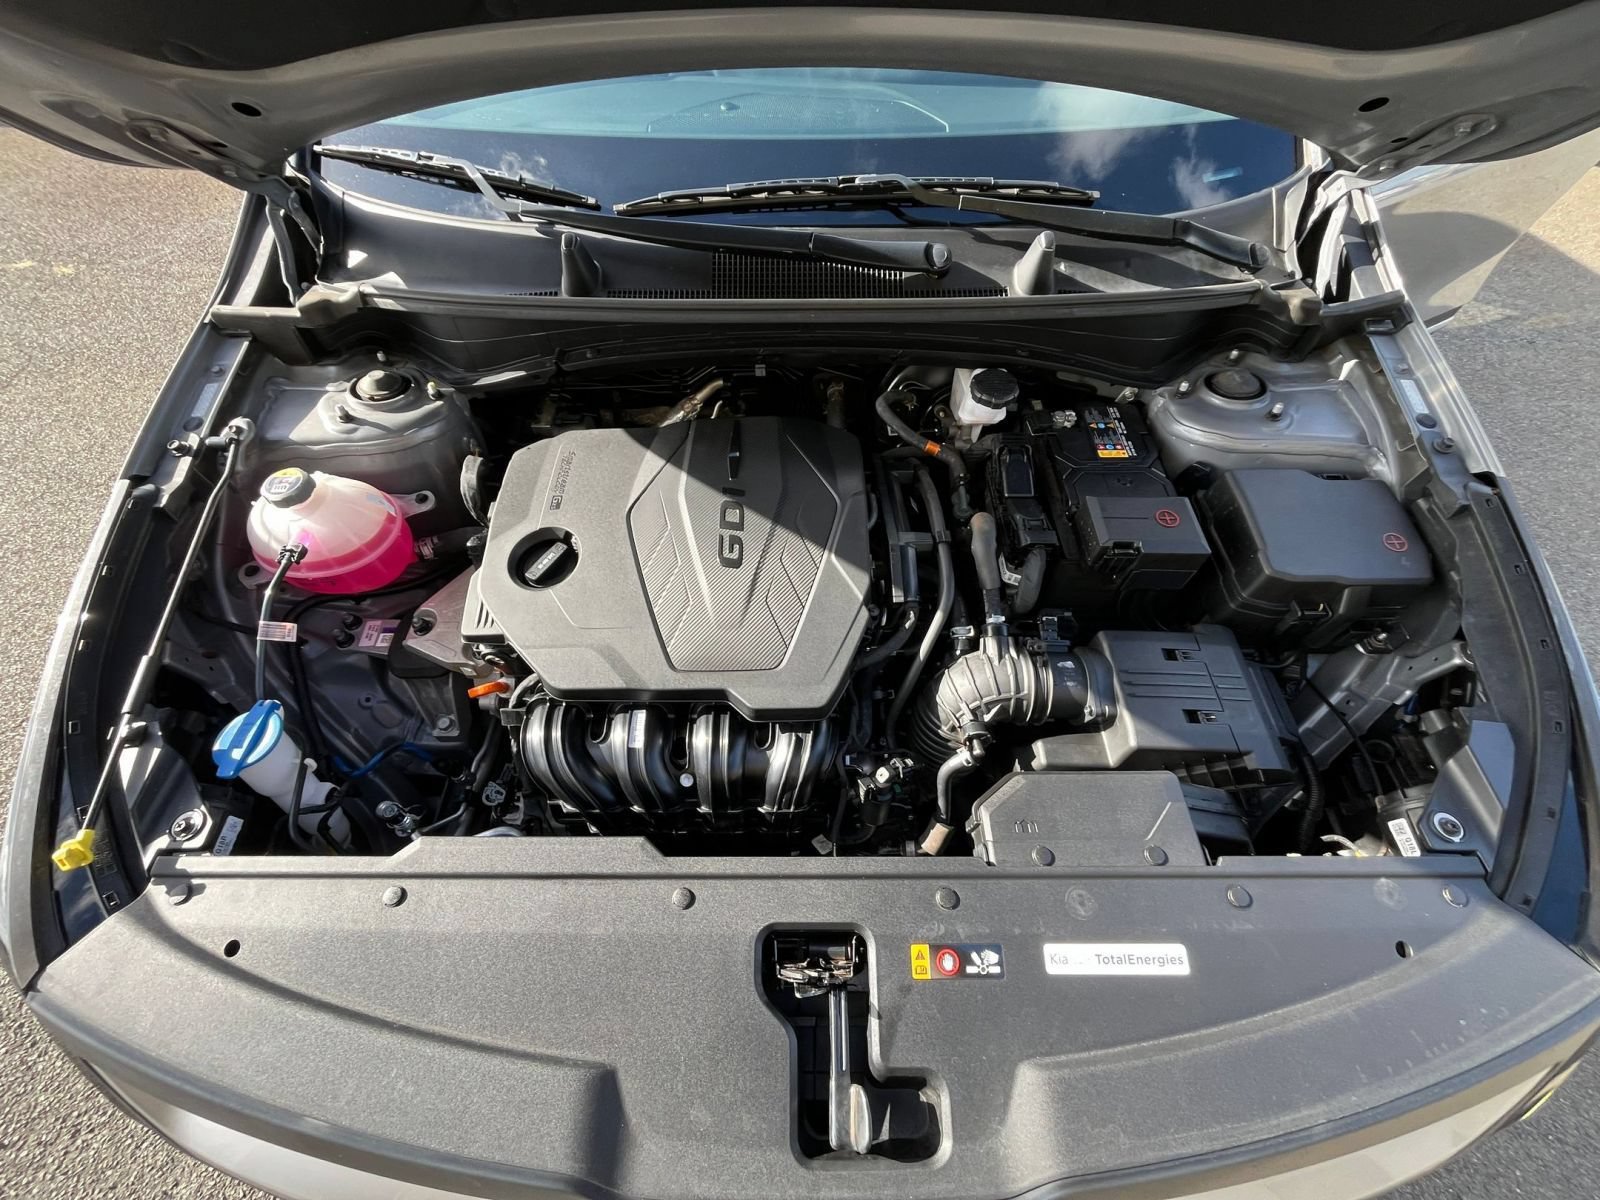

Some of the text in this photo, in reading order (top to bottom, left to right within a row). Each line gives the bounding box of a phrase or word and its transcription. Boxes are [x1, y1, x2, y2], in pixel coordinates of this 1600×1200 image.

[558, 450, 577, 495] Smartstream
[1049, 953, 1069, 966] Kia
[1094, 953, 1184, 967] TotalEnergies
